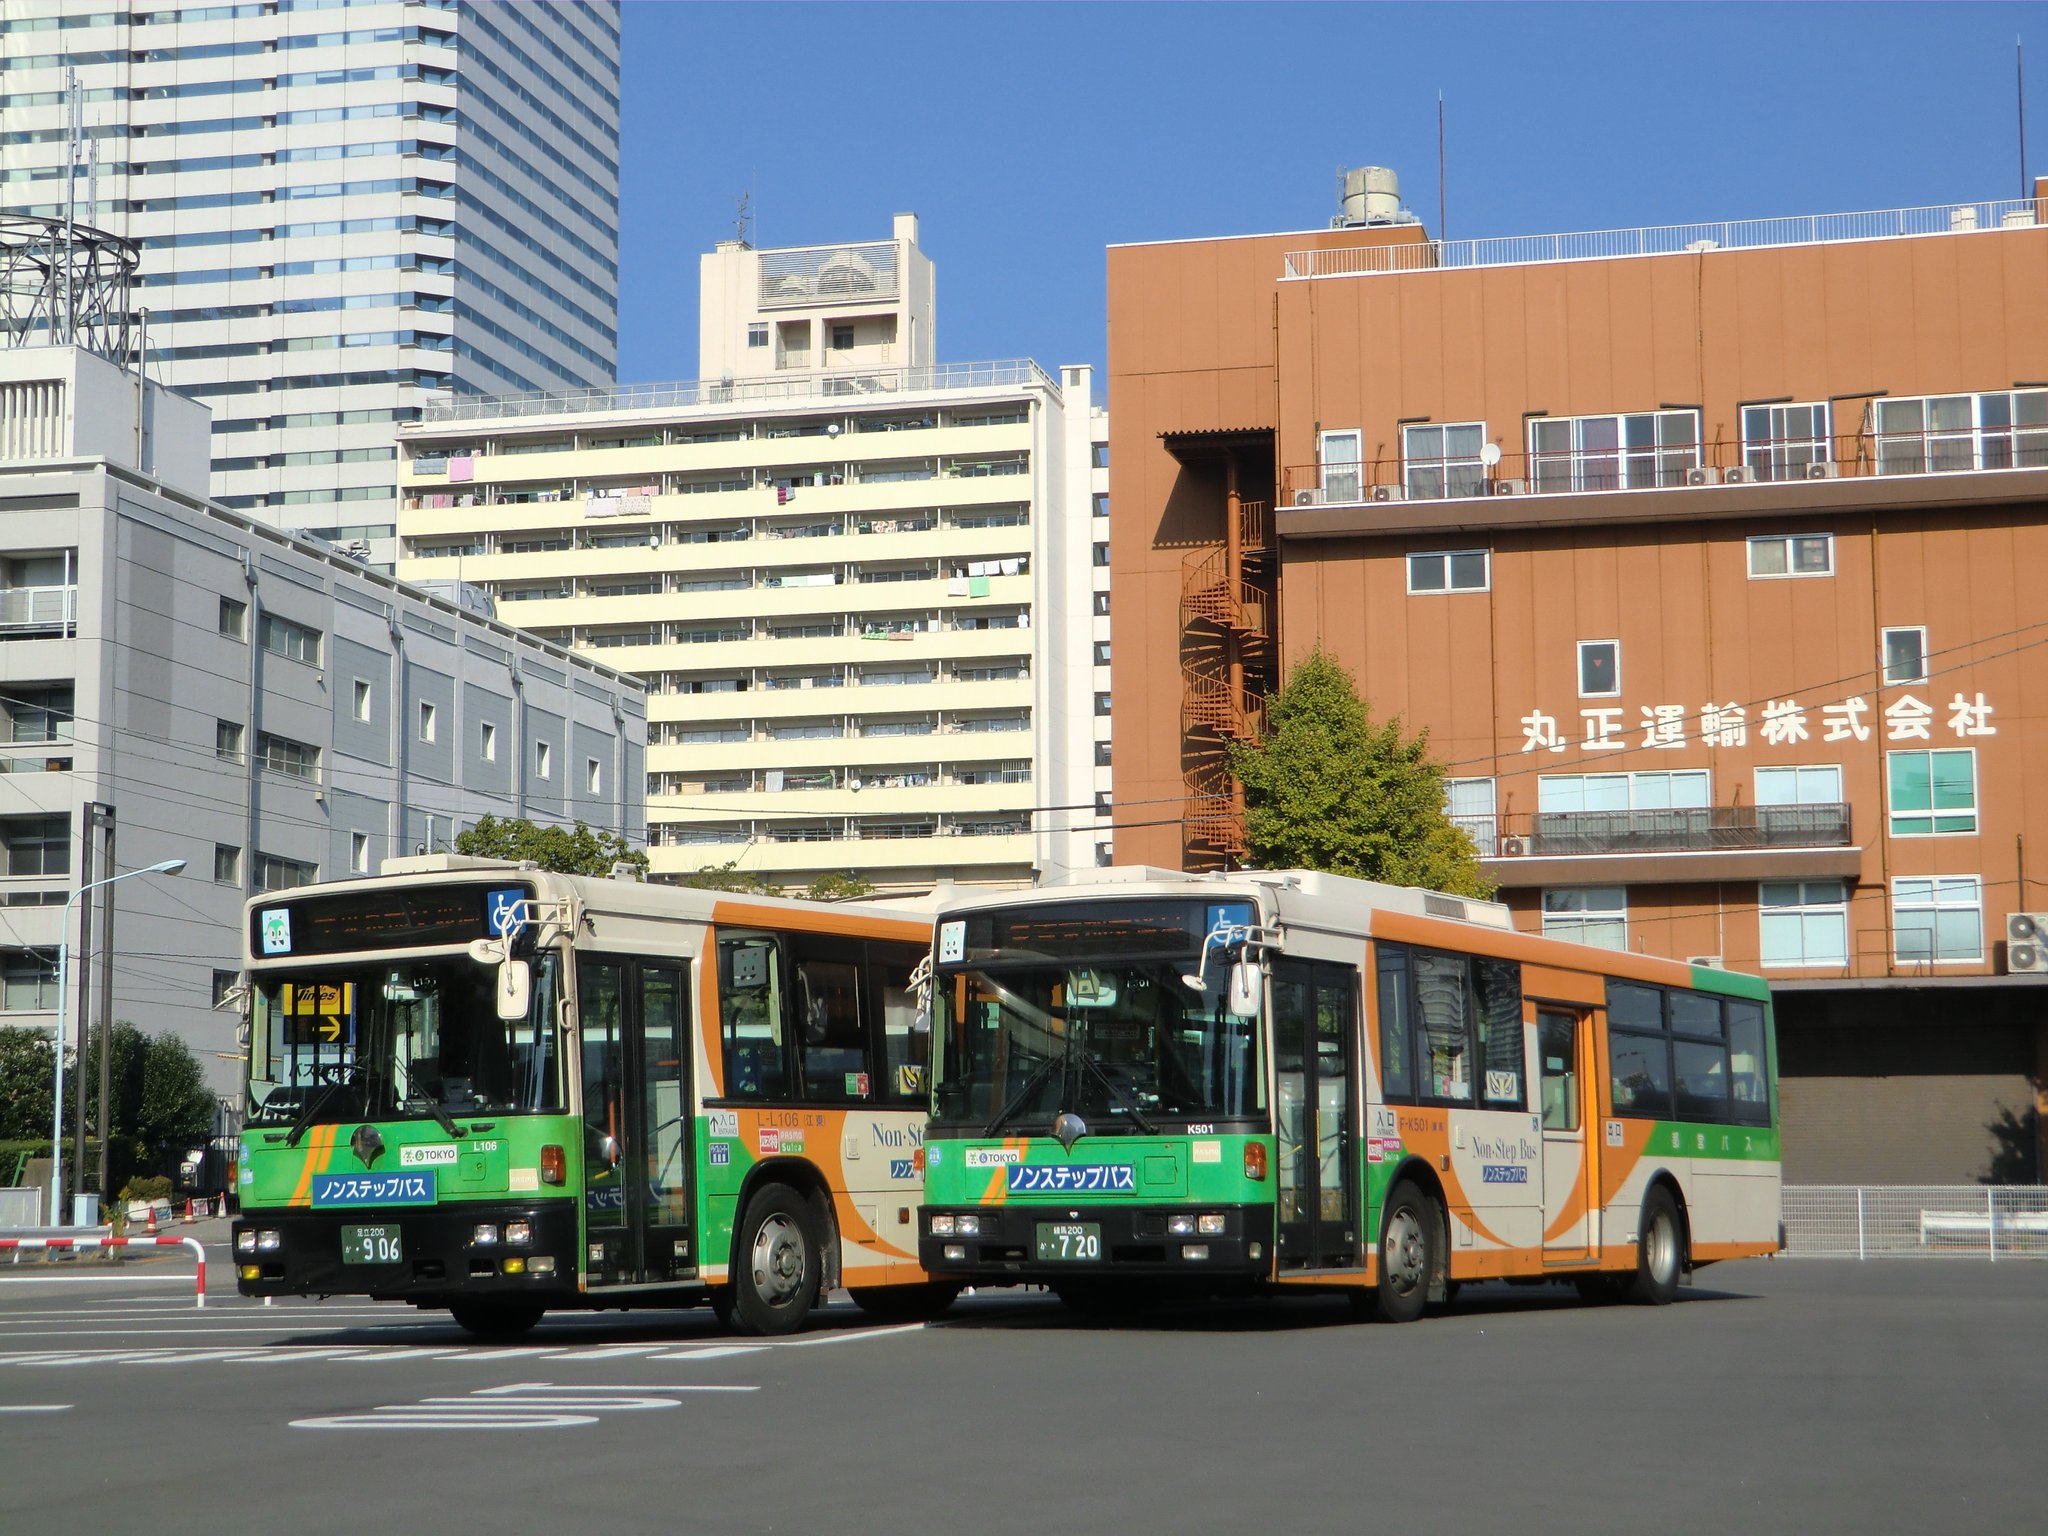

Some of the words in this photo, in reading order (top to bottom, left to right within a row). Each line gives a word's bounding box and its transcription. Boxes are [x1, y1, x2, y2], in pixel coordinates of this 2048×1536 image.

[1520, 692, 1997, 753] 丸正運輸株式会社
[719, 1114, 736, 1126] 入口
[757, 1112, 799, 1127] L-L106
[1376, 1111, 1395, 1127] 入口
[1399, 1117, 1429, 1132] F-K501
[1187, 1124, 1214, 1135] K501
[473, 1141, 497, 1151] L106
[781, 1142, 802, 1152] Suica
[1520, 1138, 1537, 1160] Bus
[1010, 1166, 1134, 1189] ノンステップバス
[1483, 1166, 1527, 1183] ノンステップバス
[320, 1178, 426, 1199] ノンステップバス
[356, 1227, 385, 1237] 足立200
